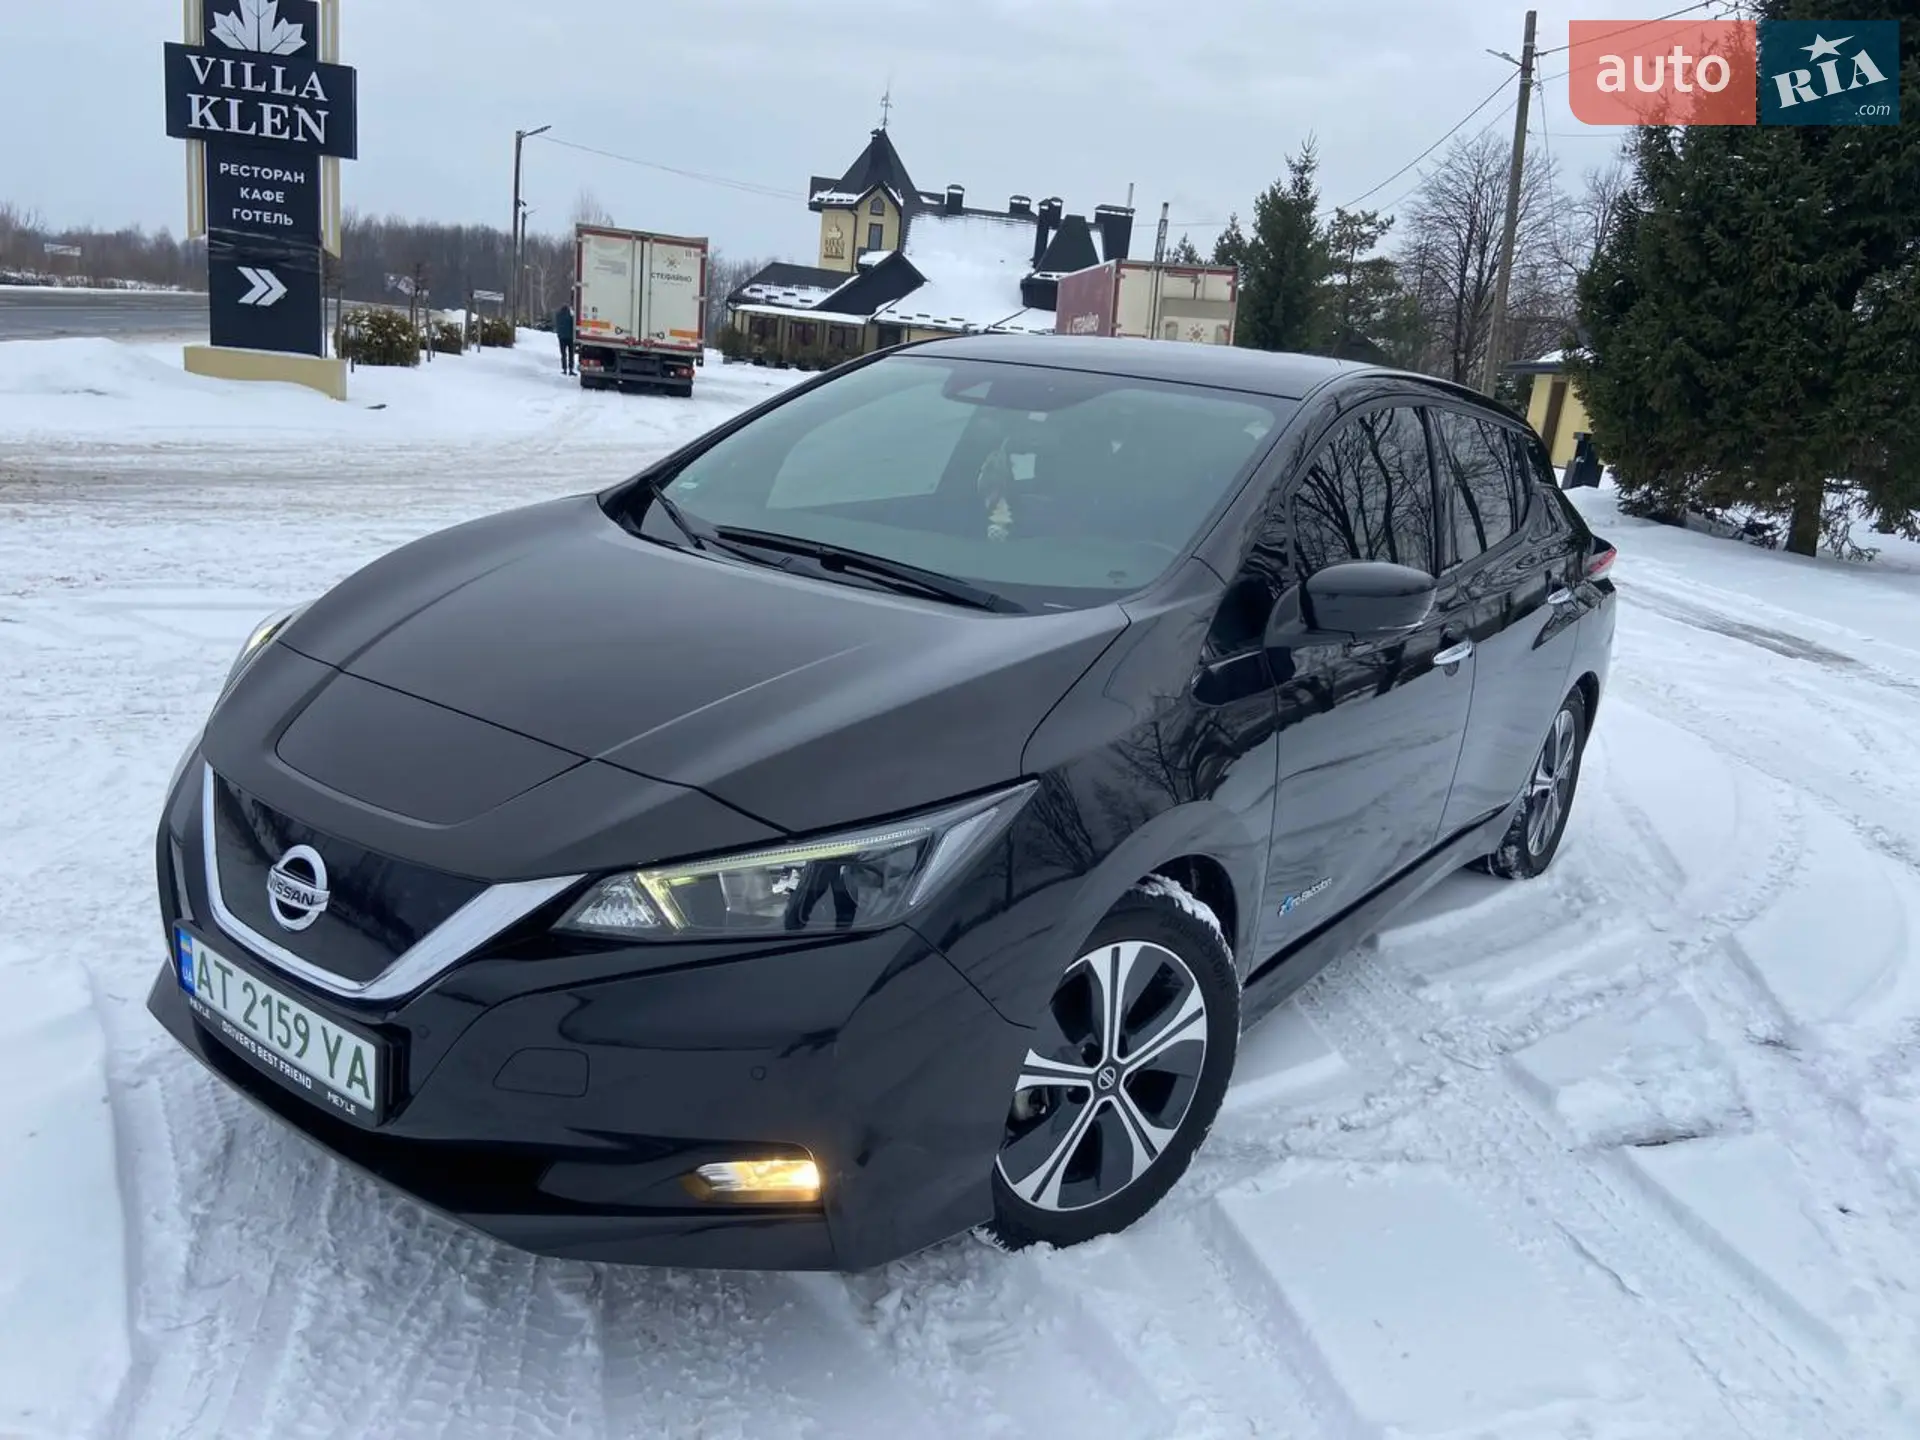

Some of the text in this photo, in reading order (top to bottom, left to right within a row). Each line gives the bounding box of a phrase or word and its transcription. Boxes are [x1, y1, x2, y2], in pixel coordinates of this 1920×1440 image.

[185, 54, 330, 102] VILLA
[186, 93, 330, 145] KLEN
[219, 162, 305, 184] РЕСТОРАН
[239, 187, 285, 204] КАФЕ
[231, 207, 294, 226] ГОТЕЛЬ
[268, 872, 316, 906] NISSAN
[197, 951, 371, 1100] AT 2159 YA
[257, 1045, 278, 1068] BEST
[280, 1060, 312, 1090] FRIEND
